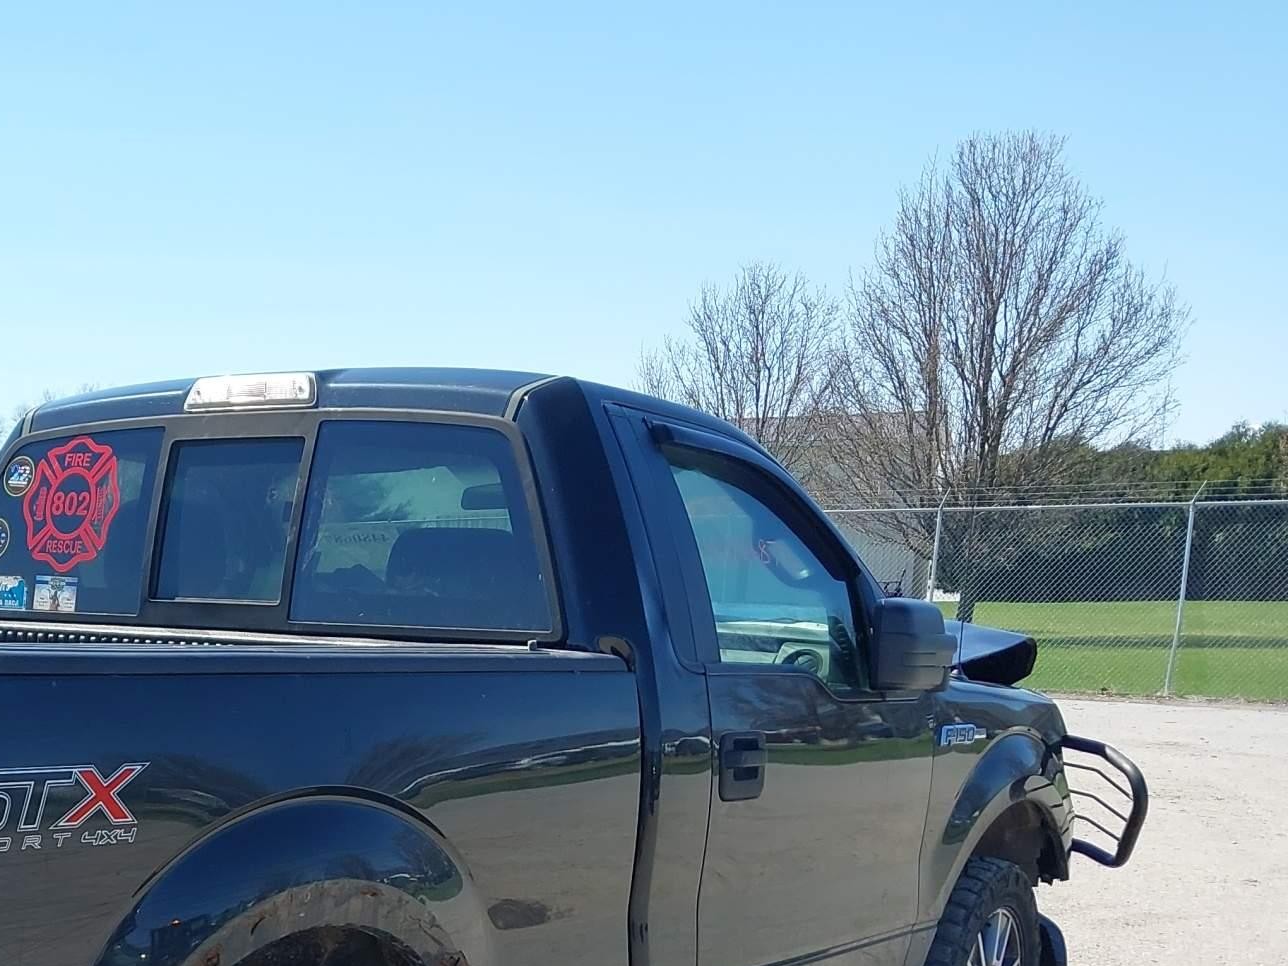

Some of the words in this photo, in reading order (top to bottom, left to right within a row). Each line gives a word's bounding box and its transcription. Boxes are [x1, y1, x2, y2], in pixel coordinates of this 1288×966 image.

[64, 453, 92, 466] FIRE
[52, 491, 90, 516] 802
[45, 540, 83, 554] RESCUE
